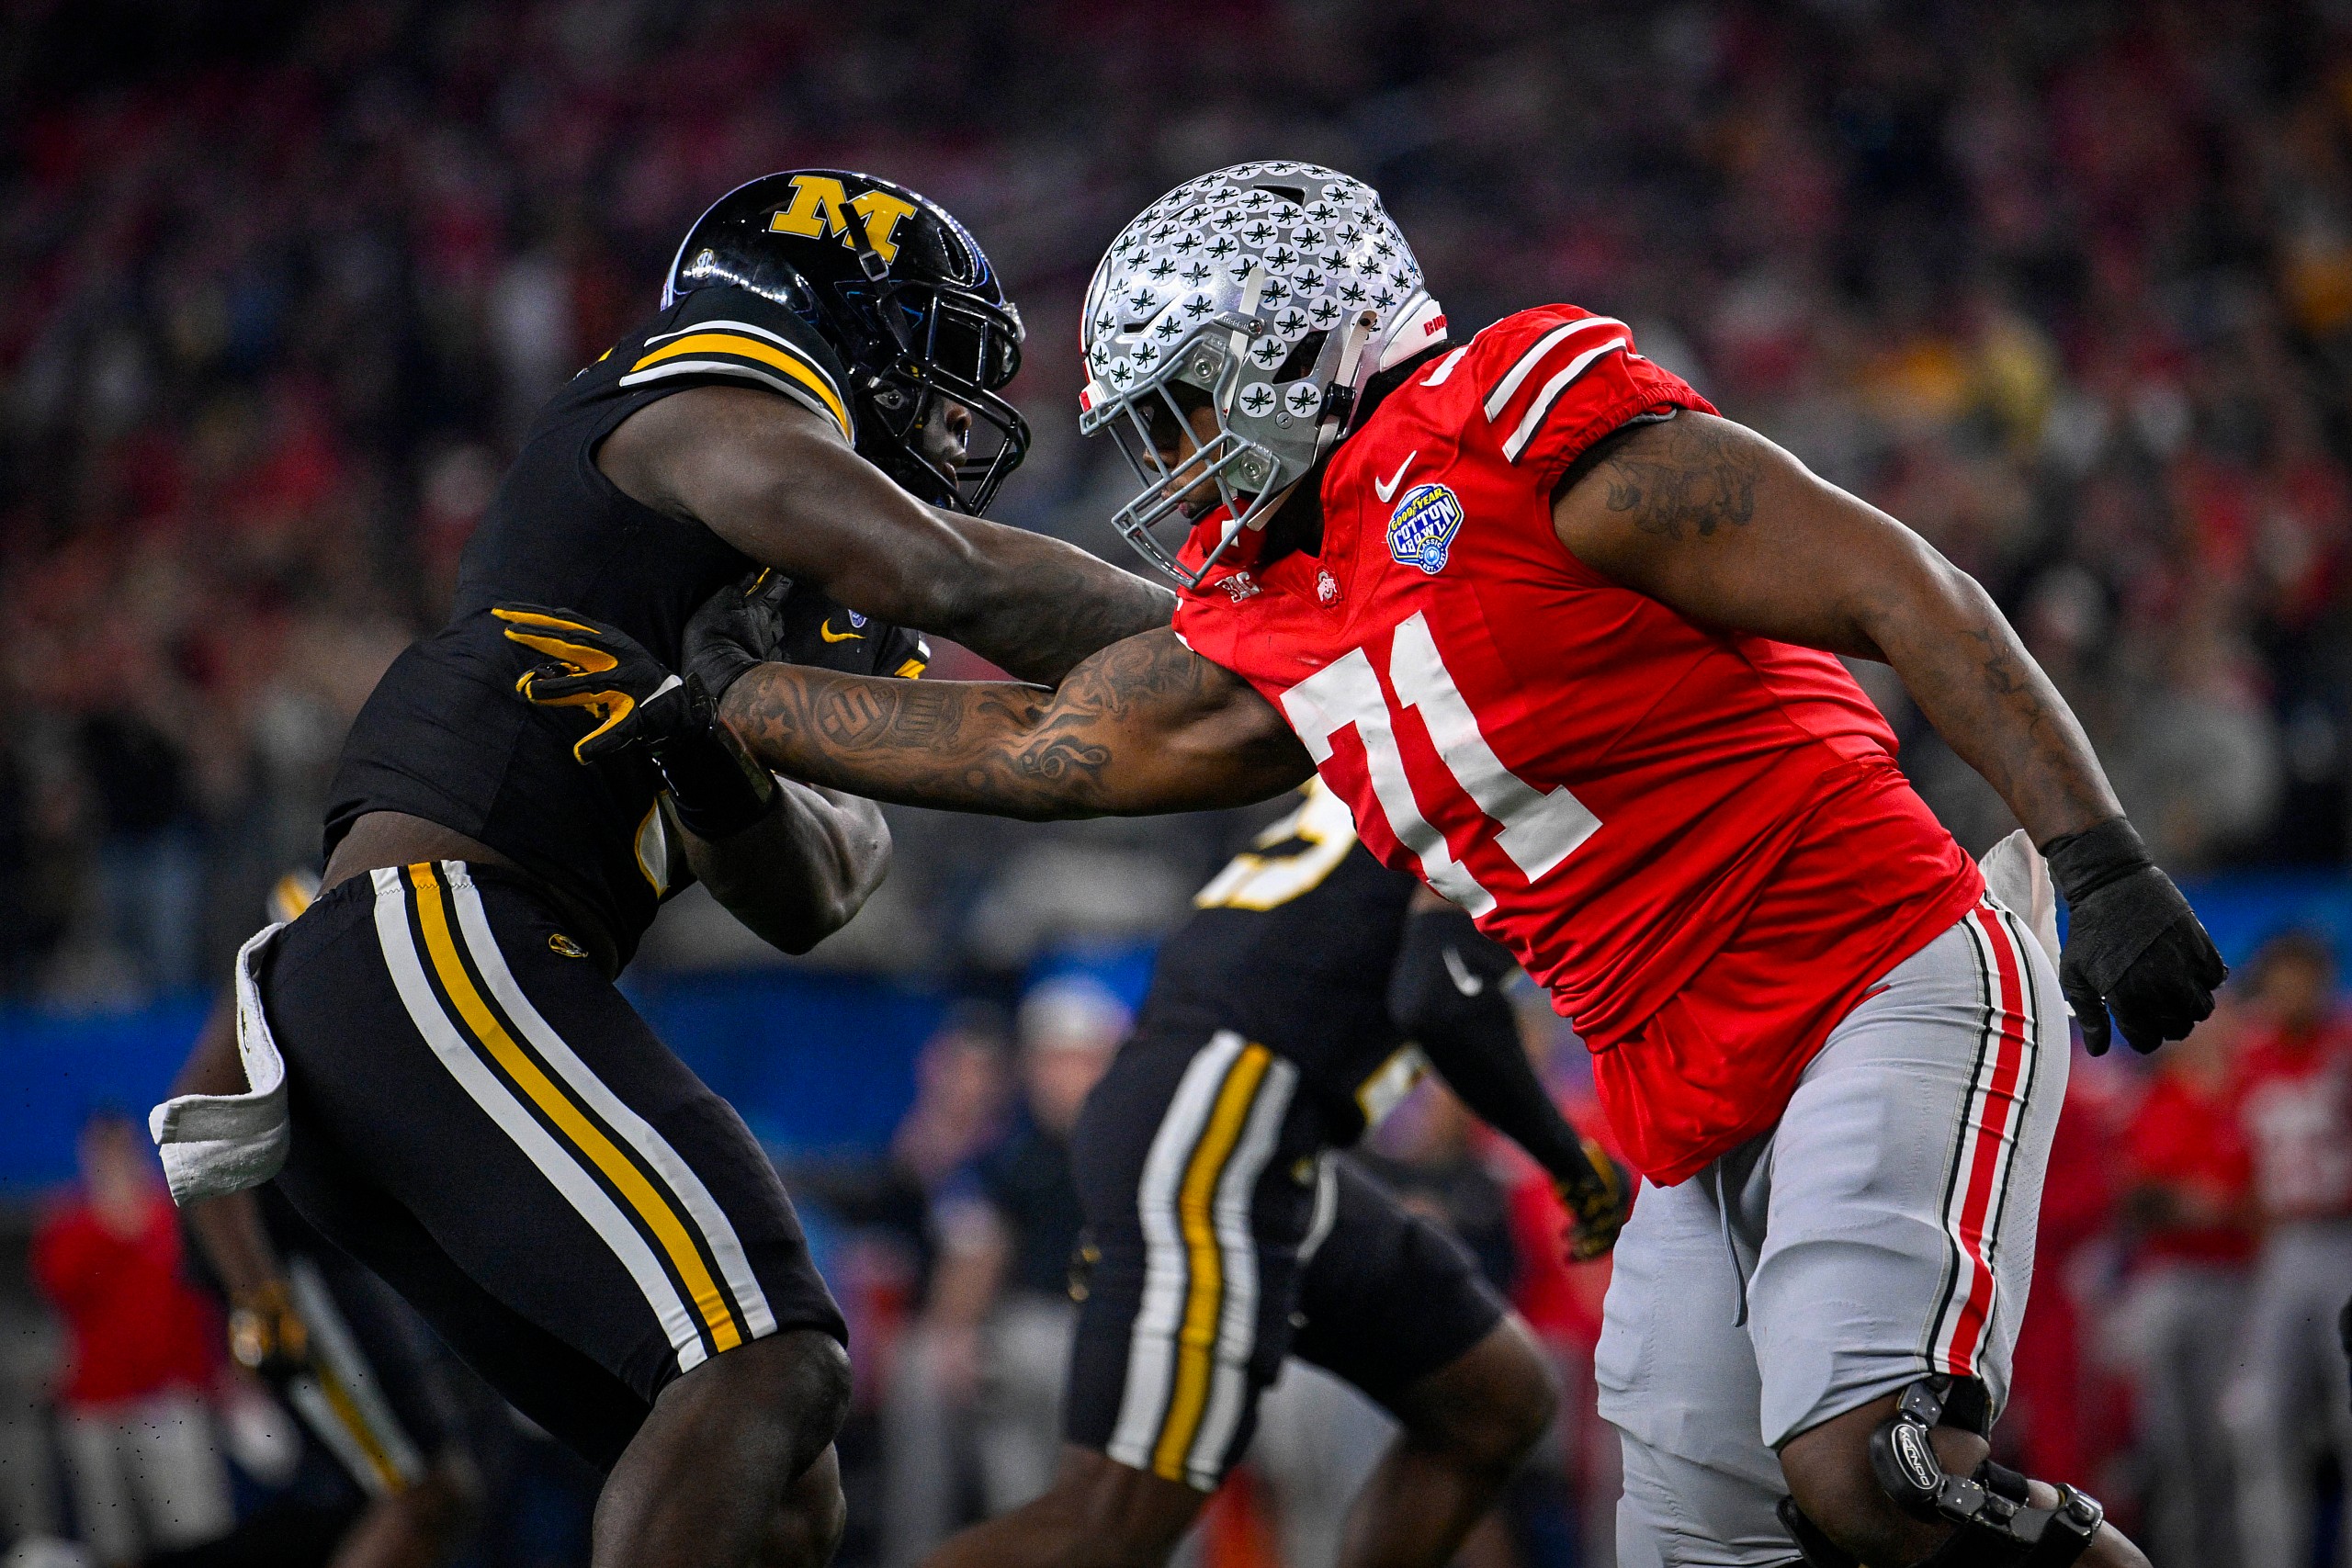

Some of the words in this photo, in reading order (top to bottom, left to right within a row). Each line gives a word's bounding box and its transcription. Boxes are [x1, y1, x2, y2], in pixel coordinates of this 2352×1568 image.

[769, 175, 917, 264] M
[1393, 497, 1456, 553] COTTON
[1406, 519, 1447, 553] BOWL
[1419, 538, 1443, 559] CLASSIC
[1280, 610, 1603, 919] 71
